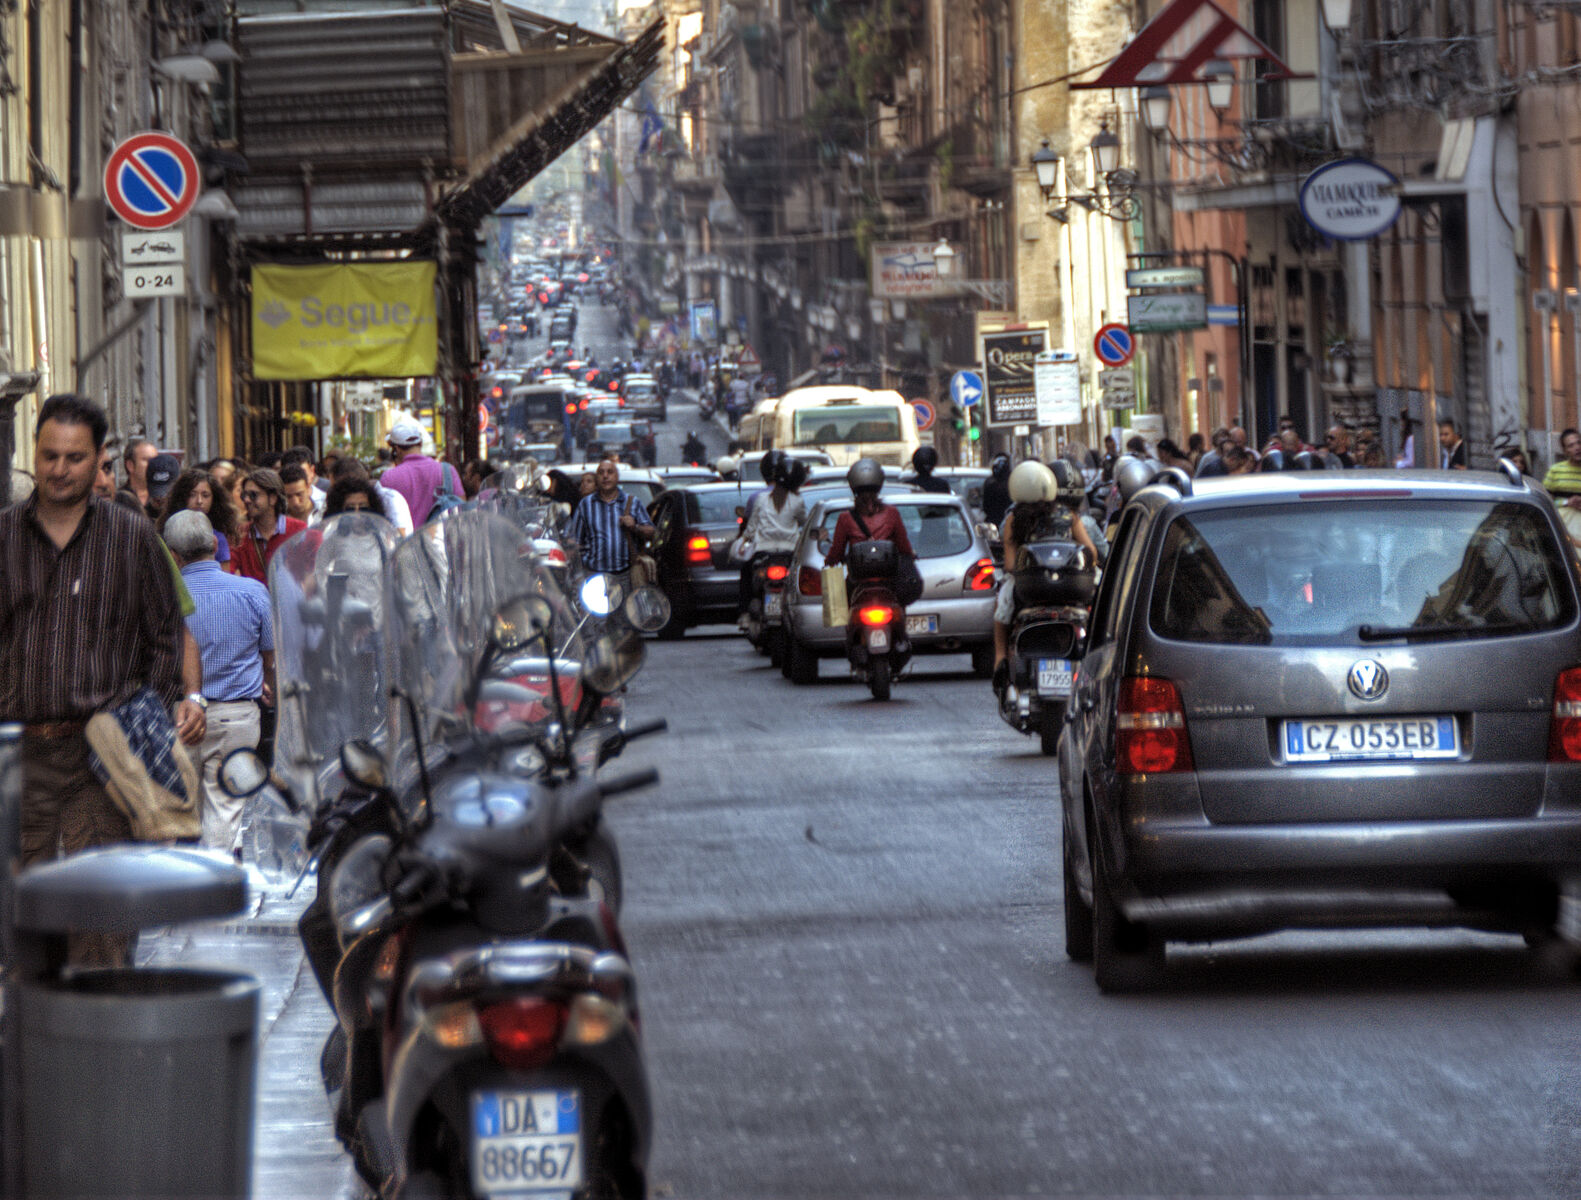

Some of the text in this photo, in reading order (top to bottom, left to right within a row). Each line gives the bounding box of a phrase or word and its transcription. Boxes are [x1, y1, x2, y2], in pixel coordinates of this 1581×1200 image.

[300, 295, 433, 334] Segue...
[988, 346, 1033, 367] Opera
[1349, 721, 1436, 750] 053EB
[502, 1097, 539, 1133] DA
[482, 1143, 576, 1182] 88667
